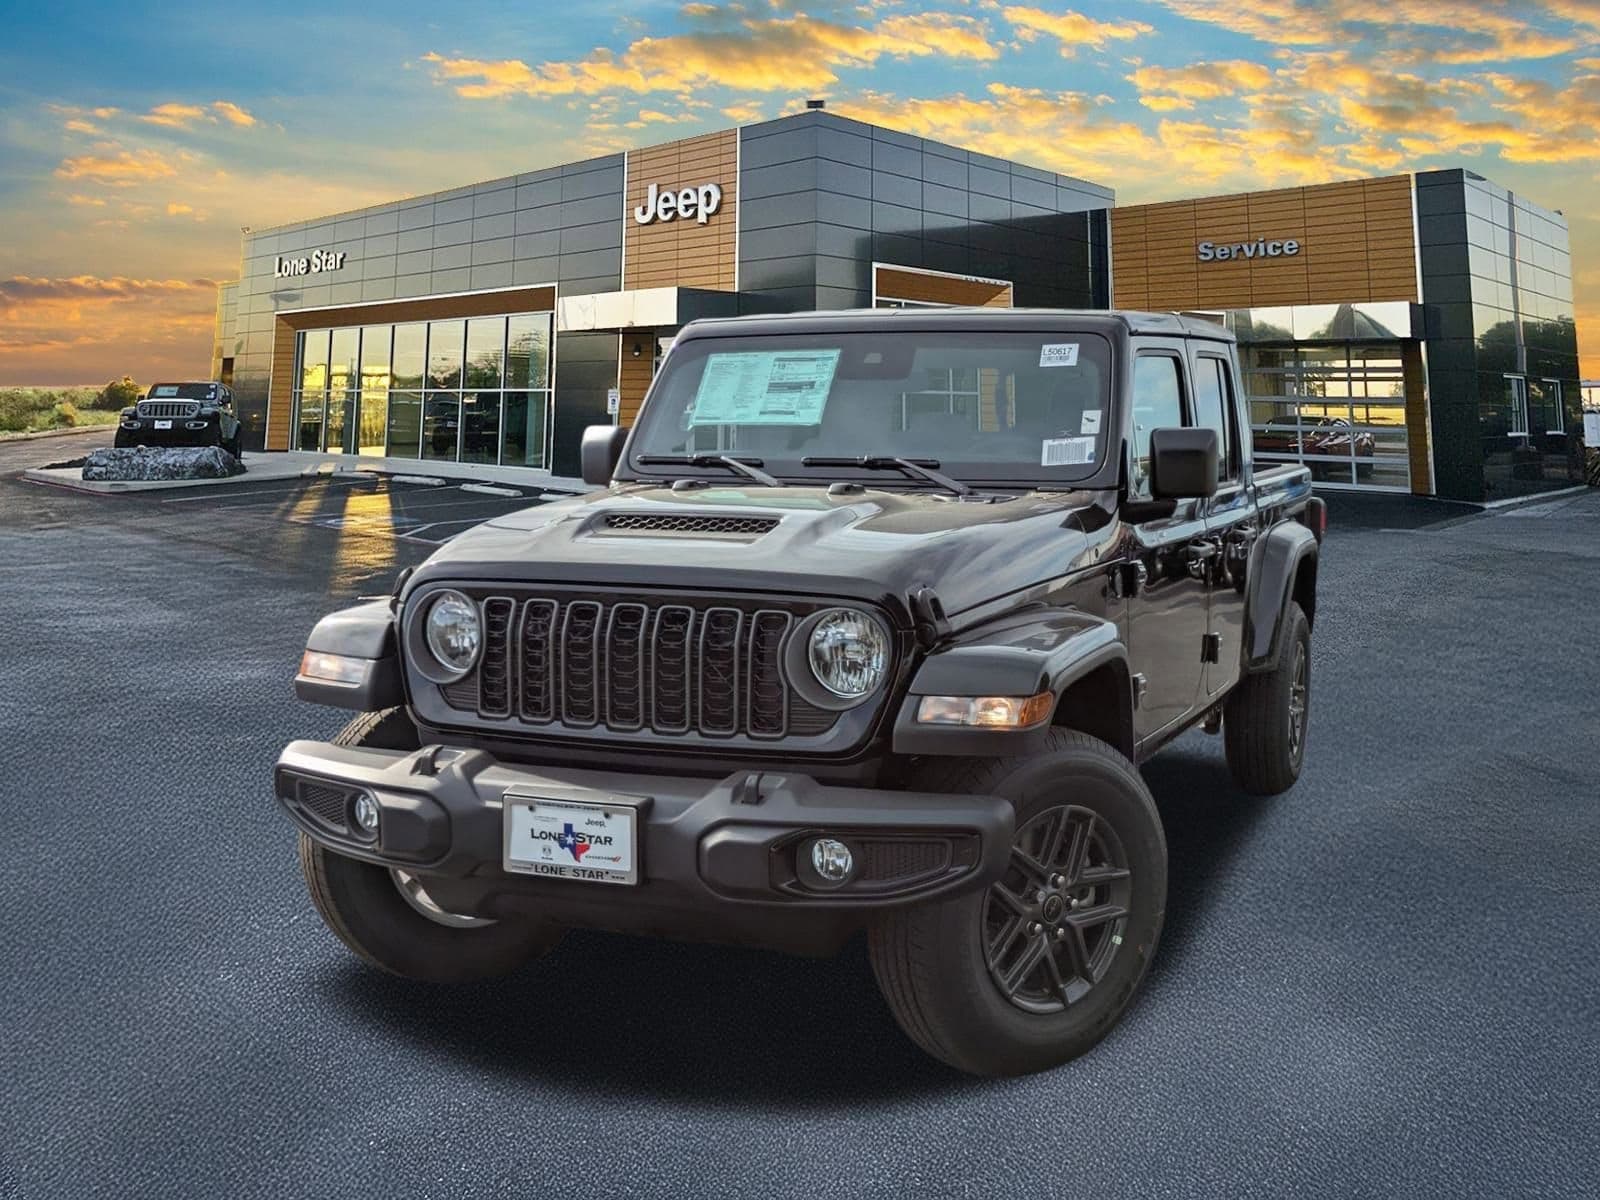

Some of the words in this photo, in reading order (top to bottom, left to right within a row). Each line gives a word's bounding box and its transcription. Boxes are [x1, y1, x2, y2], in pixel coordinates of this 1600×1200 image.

[634, 183, 722, 225] Jeep
[1198, 236, 1300, 261] Service
[274, 256, 309, 279] Lone
[311, 249, 346, 273] Star
[530, 827, 566, 842] LONE
[575, 831, 613, 846] STAR
[534, 864, 566, 877] LONE
[572, 868, 605, 880] STAR
